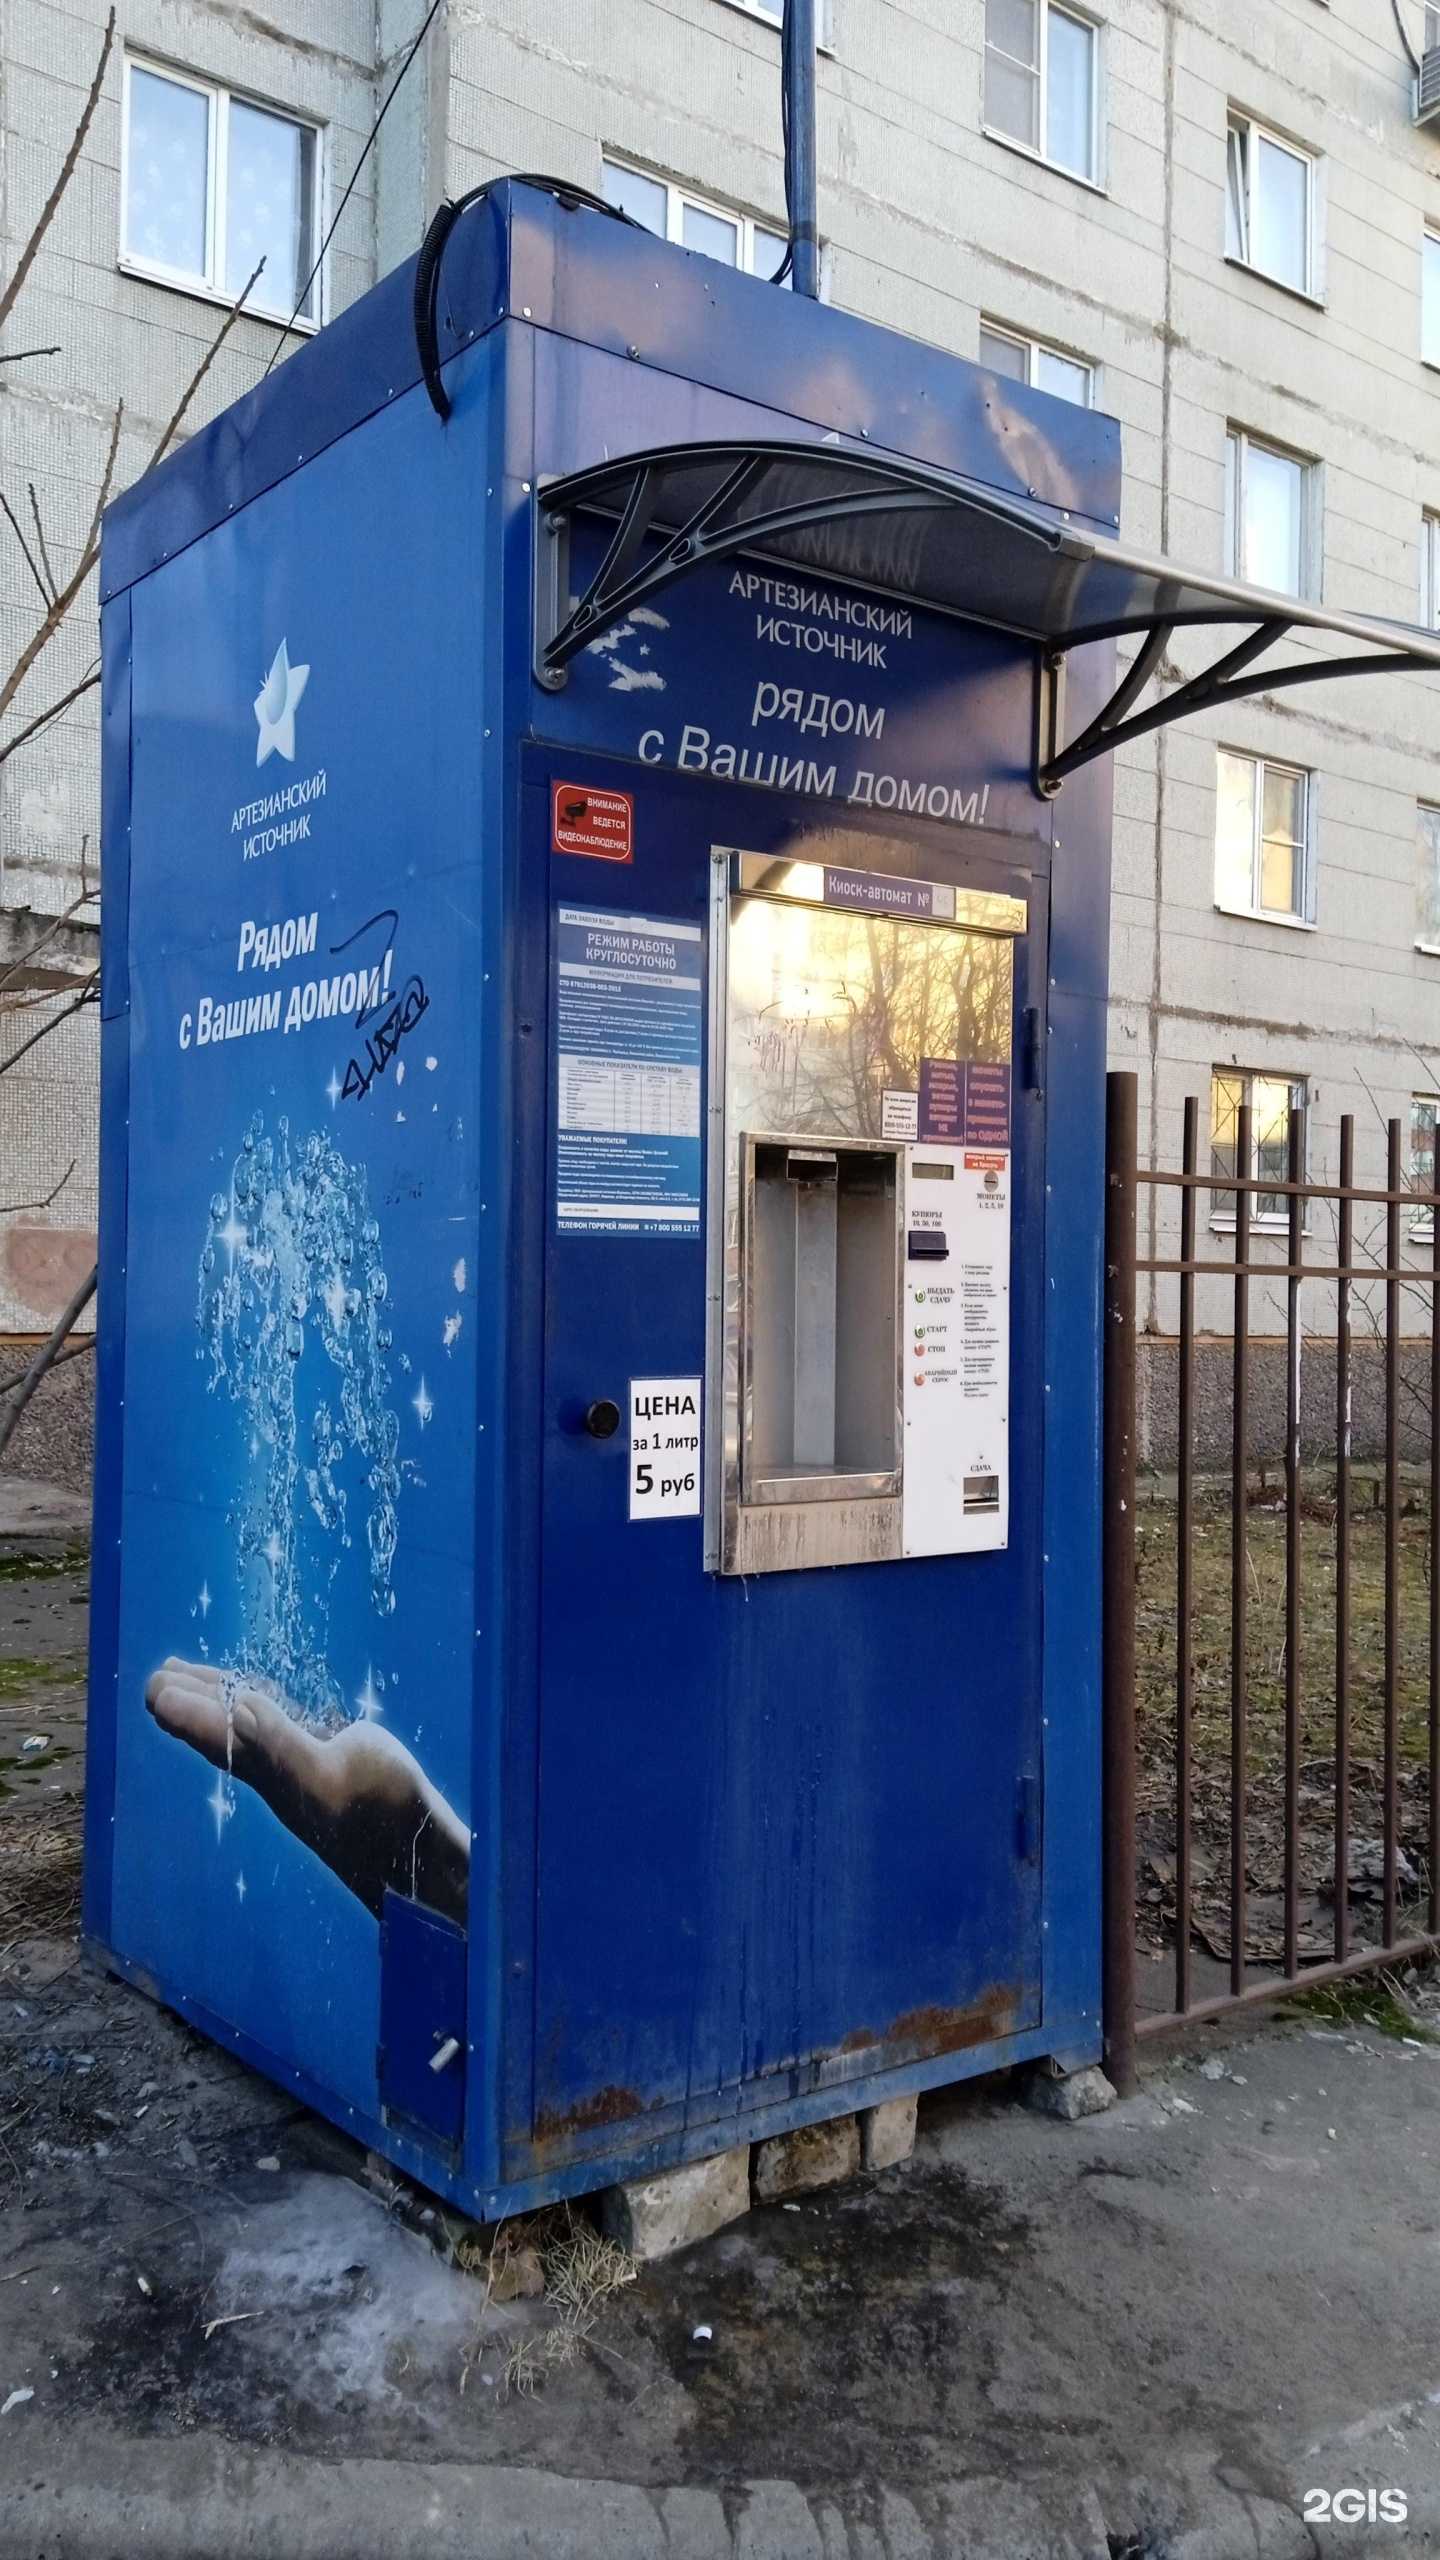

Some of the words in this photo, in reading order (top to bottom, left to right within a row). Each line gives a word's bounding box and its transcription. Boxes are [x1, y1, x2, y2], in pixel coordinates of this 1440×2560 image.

[729, 571, 912, 640] АРТЕЗИАНСКИЙ
[756, 615, 887, 669] ИСТОЧНИК
[752, 680, 885, 739] рядом
[638, 728, 666, 764] с
[678, 725, 835, 797] Вашим
[848, 770, 990, 825] домом!
[231, 769, 327, 833] АРТЕЗИАНСКИЙ
[587, 797, 627, 813] ВНИМАНИЕ
[243, 814, 311, 861] ИСТОЧНИК
[592, 815, 626, 830] ВЕДЕТСЯ
[558, 830, 628, 851] ВИДЕОНАБЛЮДЕНИЕ
[828, 875, 913, 904] Киоск-автомат
[237, 912, 319, 972] Рядом
[587, 932, 630, 950] РЕЖИМ
[632, 939, 675, 956] РАБОТЫ
[586, 947, 677, 970] КРУГЛОСУТОЧНО
[179, 1013, 192, 1050] с
[196, 990, 280, 1046] Вашим
[284, 948, 394, 1034] домом!
[635, 1395, 696, 1421] ЦЕНА
[632, 1439, 648, 1451] за
[652, 1433, 661, 1449] 1
[665, 1436, 699, 1451] литр
[635, 1464, 654, 1495] 5
[660, 1473, 695, 1497] руб
[970, 1464, 992, 1472] СДАЧА
